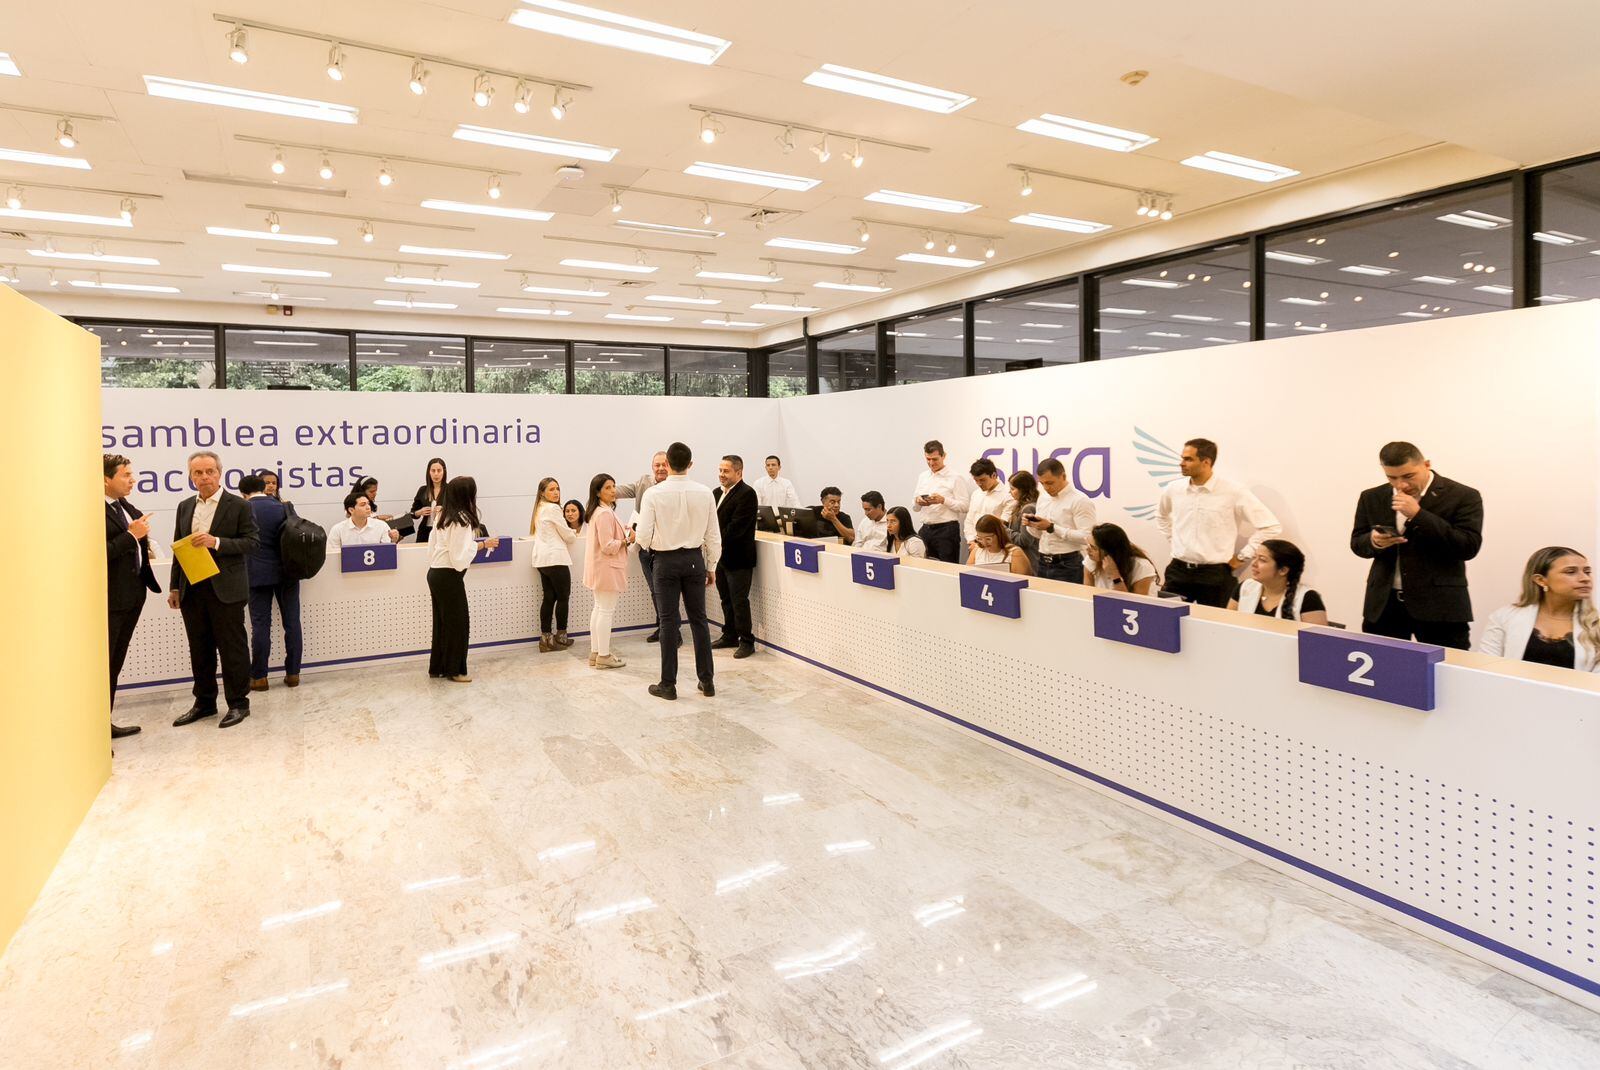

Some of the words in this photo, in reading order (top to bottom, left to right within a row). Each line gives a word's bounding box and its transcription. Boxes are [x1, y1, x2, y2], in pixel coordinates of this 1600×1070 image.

[295, 418, 541, 446] extraordinaria
[981, 414, 1049, 438] GRUPO
[363, 549, 376, 566] 8
[794, 548, 802, 565] 6
[865, 562, 876, 581] 5
[980, 584, 995, 607] 4
[1122, 608, 1140, 636] 3
[1347, 651, 1375, 687] 2
